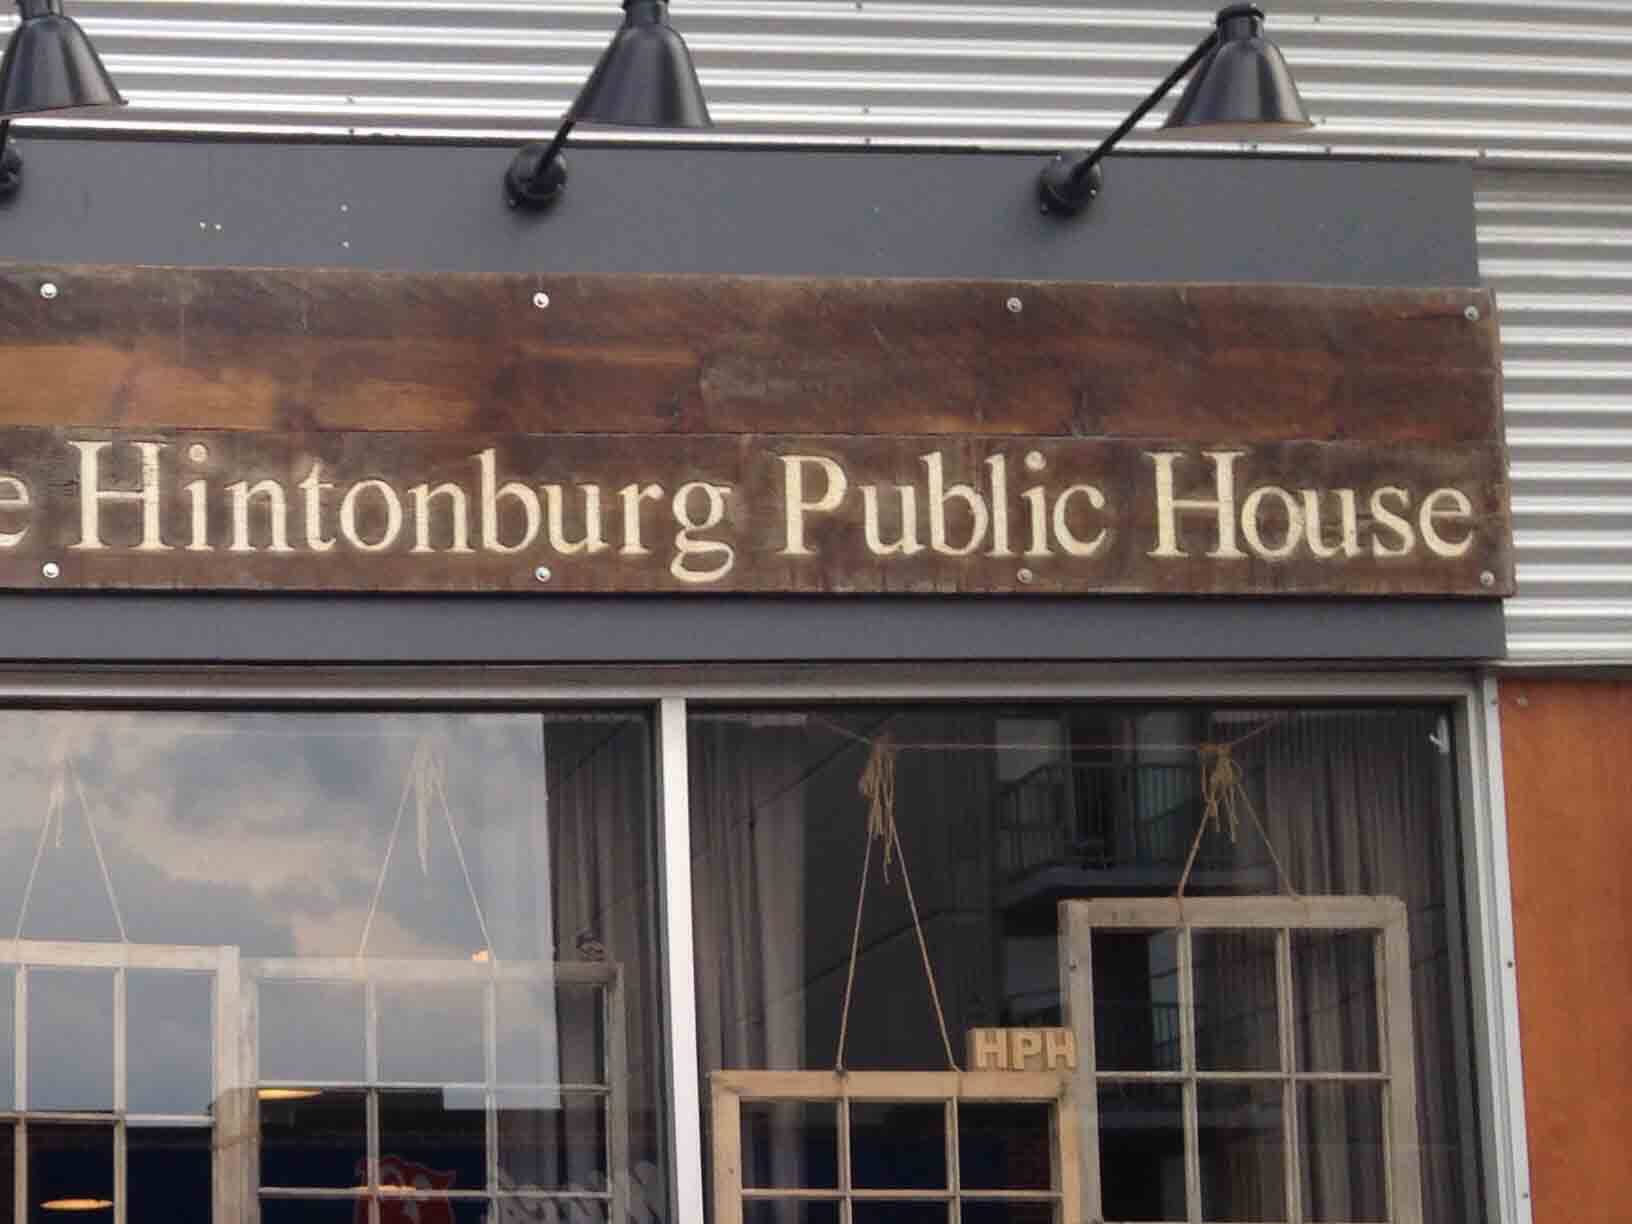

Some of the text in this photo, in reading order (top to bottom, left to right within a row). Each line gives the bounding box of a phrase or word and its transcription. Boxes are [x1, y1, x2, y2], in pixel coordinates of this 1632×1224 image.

[68, 439, 736, 583] Hintonburg
[776, 450, 1111, 559] Public
[1143, 450, 1474, 562] House
[974, 1028, 1076, 1071] HPH
